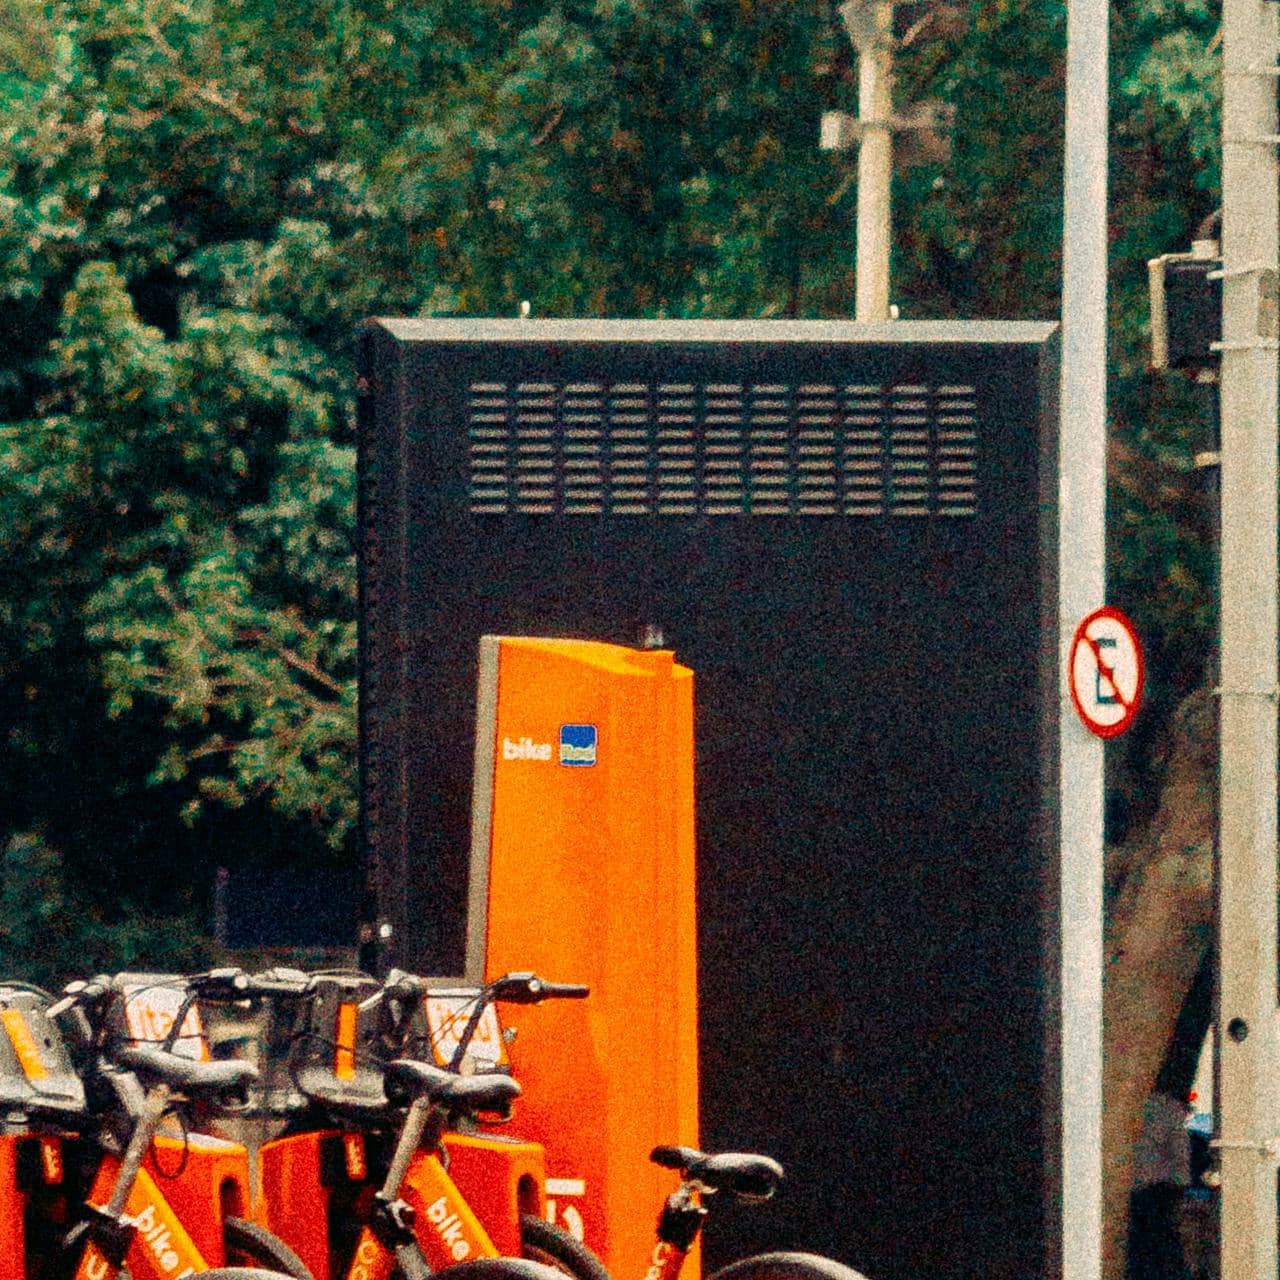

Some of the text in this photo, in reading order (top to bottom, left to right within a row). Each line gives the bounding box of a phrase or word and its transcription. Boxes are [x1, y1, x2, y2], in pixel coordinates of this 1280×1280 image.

[503, 737, 552, 760] bike
[136, 1205, 180, 1271] bike
[427, 1196, 470, 1261] bike
